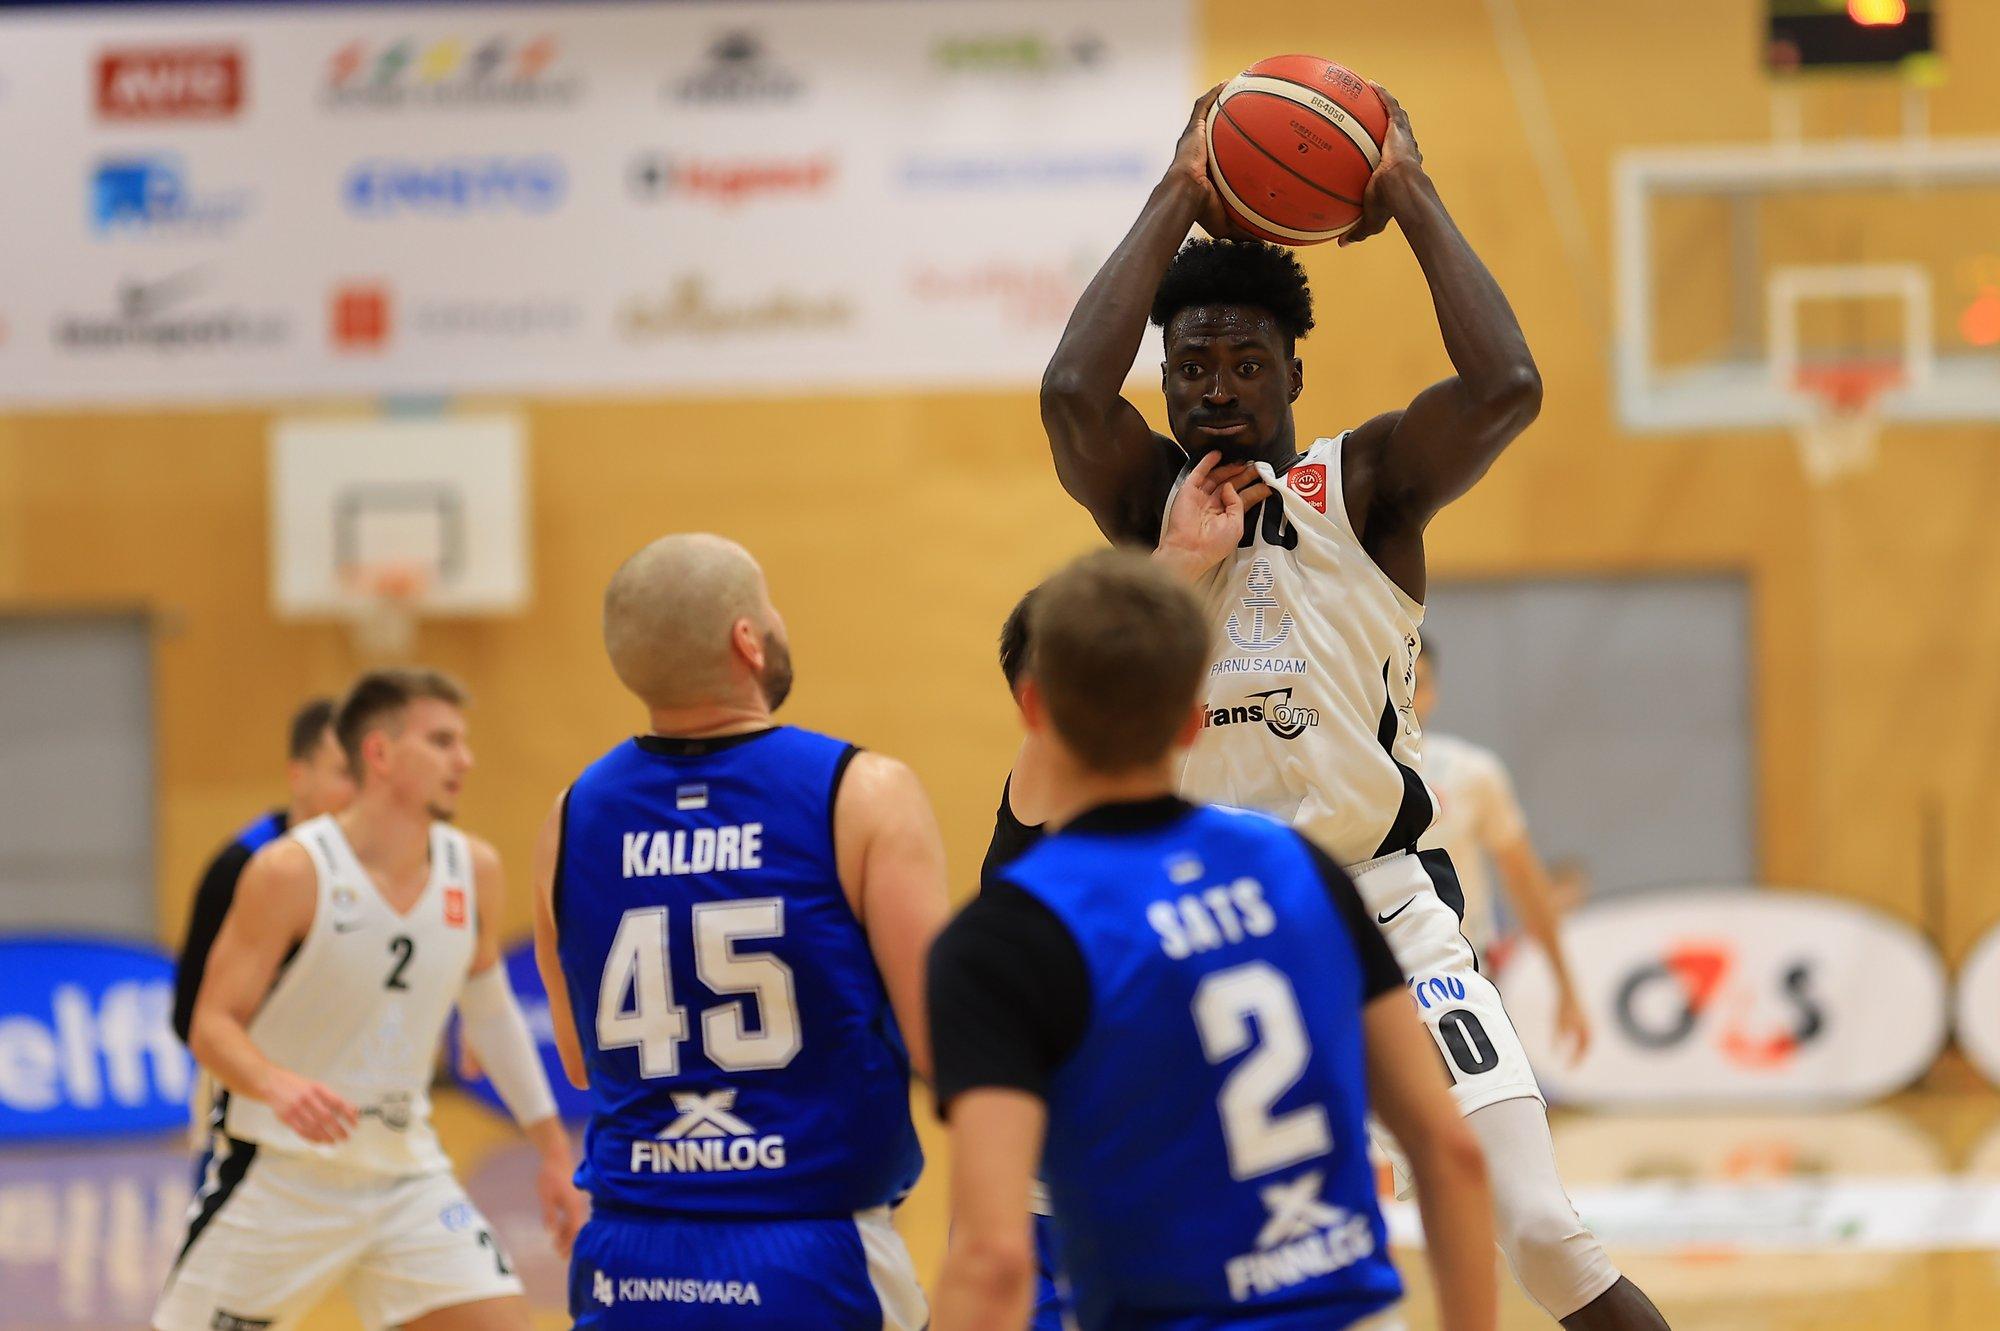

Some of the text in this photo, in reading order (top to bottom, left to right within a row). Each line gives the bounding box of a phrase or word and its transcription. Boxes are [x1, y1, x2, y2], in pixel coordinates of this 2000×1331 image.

[1310, 97, 1345, 123] BG4050
[1253, 658, 1307, 674] SADAM
[622, 823, 764, 879] KALDRE
[1146, 877, 1277, 960] SATS
[385, 933, 416, 990] 2
[596, 896, 803, 1080] 45
[1191, 958, 1334, 1182] 2
[630, 1135, 785, 1173] FINNLOG
[618, 1276, 762, 1307] KINNISVARA
